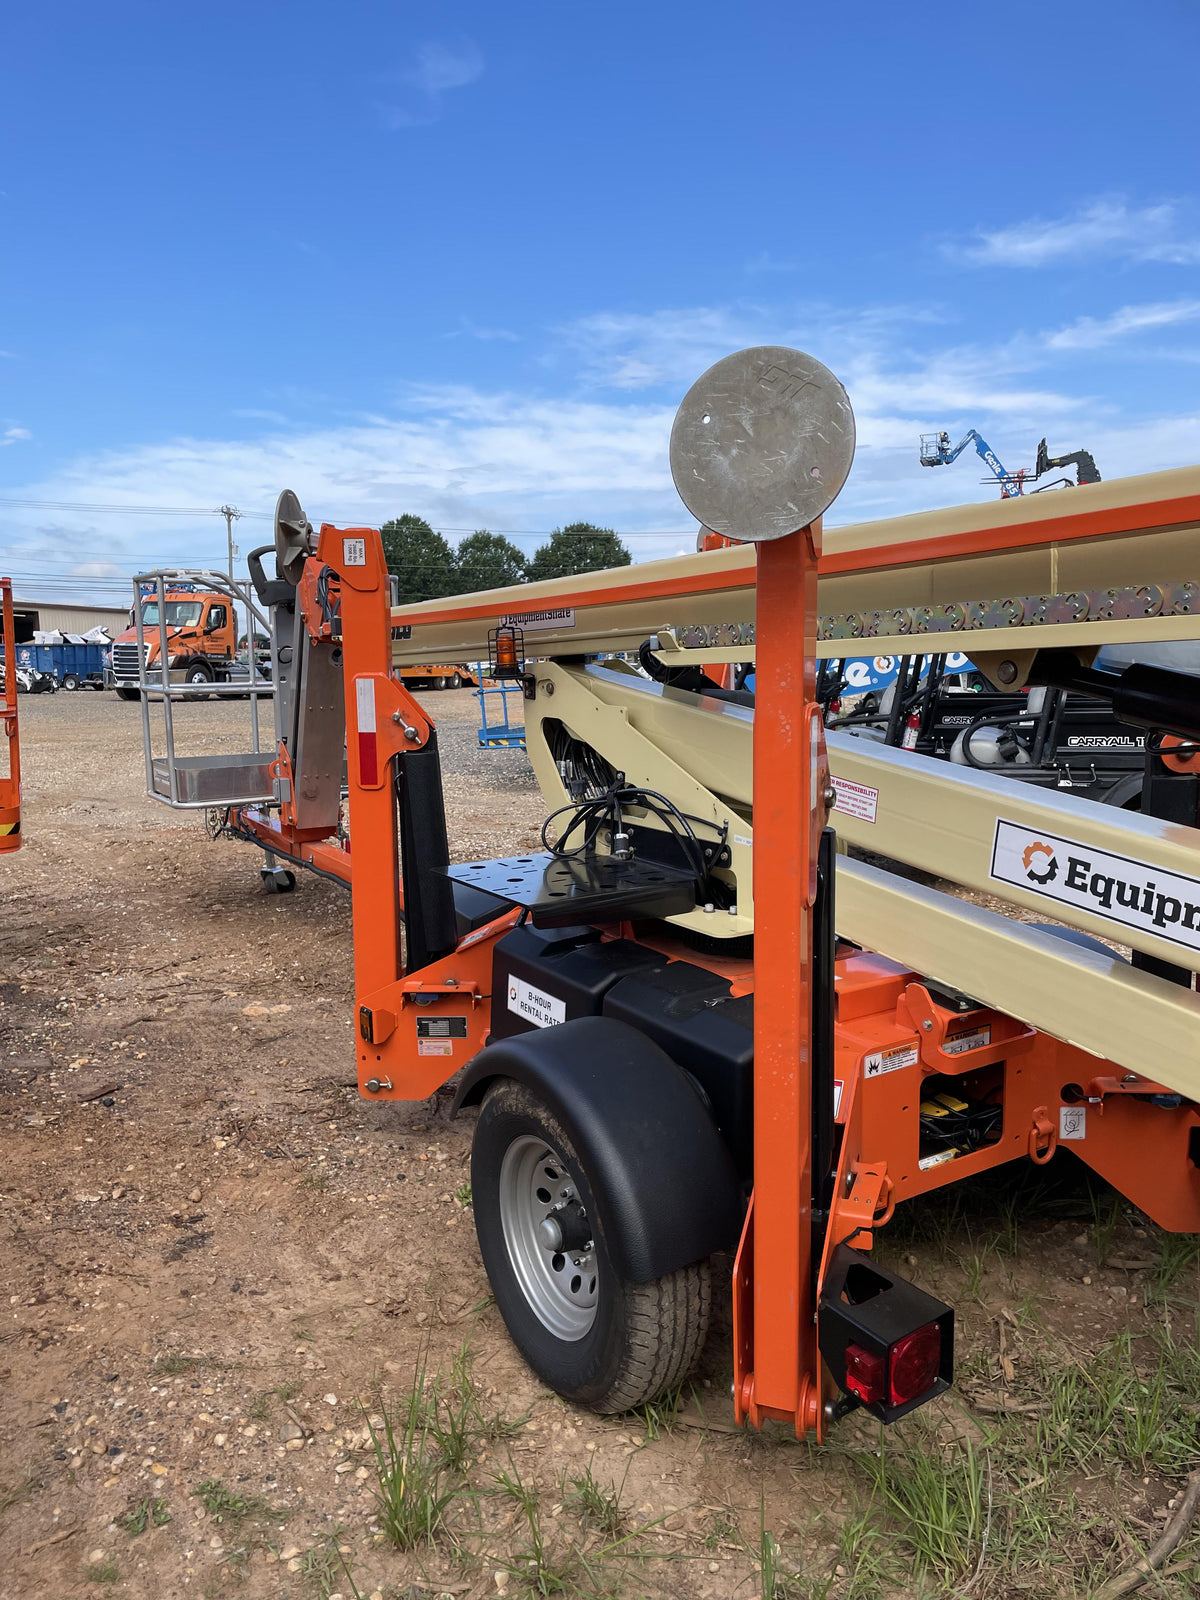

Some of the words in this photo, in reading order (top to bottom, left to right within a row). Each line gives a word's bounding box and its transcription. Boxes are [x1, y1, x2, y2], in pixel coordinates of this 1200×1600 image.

[984, 450, 1001, 474] Genie
[1067, 736, 1135, 747] CARRYALL
[836, 780, 877, 798] RESPONSIBILITY
[520, 1001, 543, 1021] RENTAL
